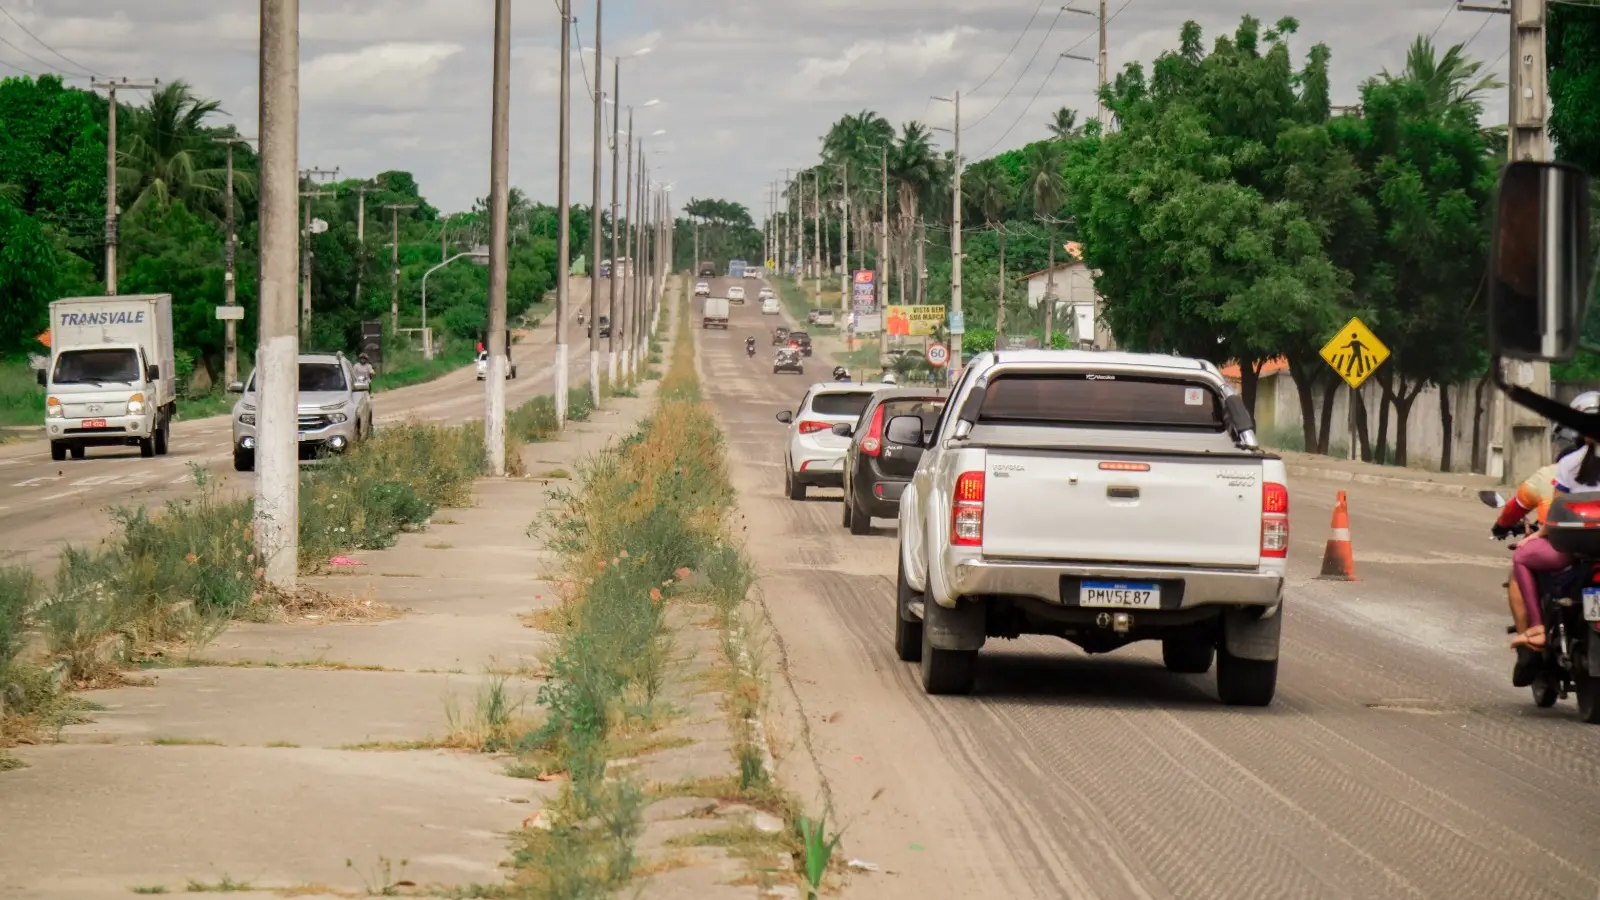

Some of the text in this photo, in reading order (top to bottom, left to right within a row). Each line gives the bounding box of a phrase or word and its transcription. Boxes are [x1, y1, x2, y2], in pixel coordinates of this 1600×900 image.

[61, 311, 144, 326] TRANSVALE
[930, 348, 945, 358] 60
[1088, 589, 1151, 605] PMV5E87
